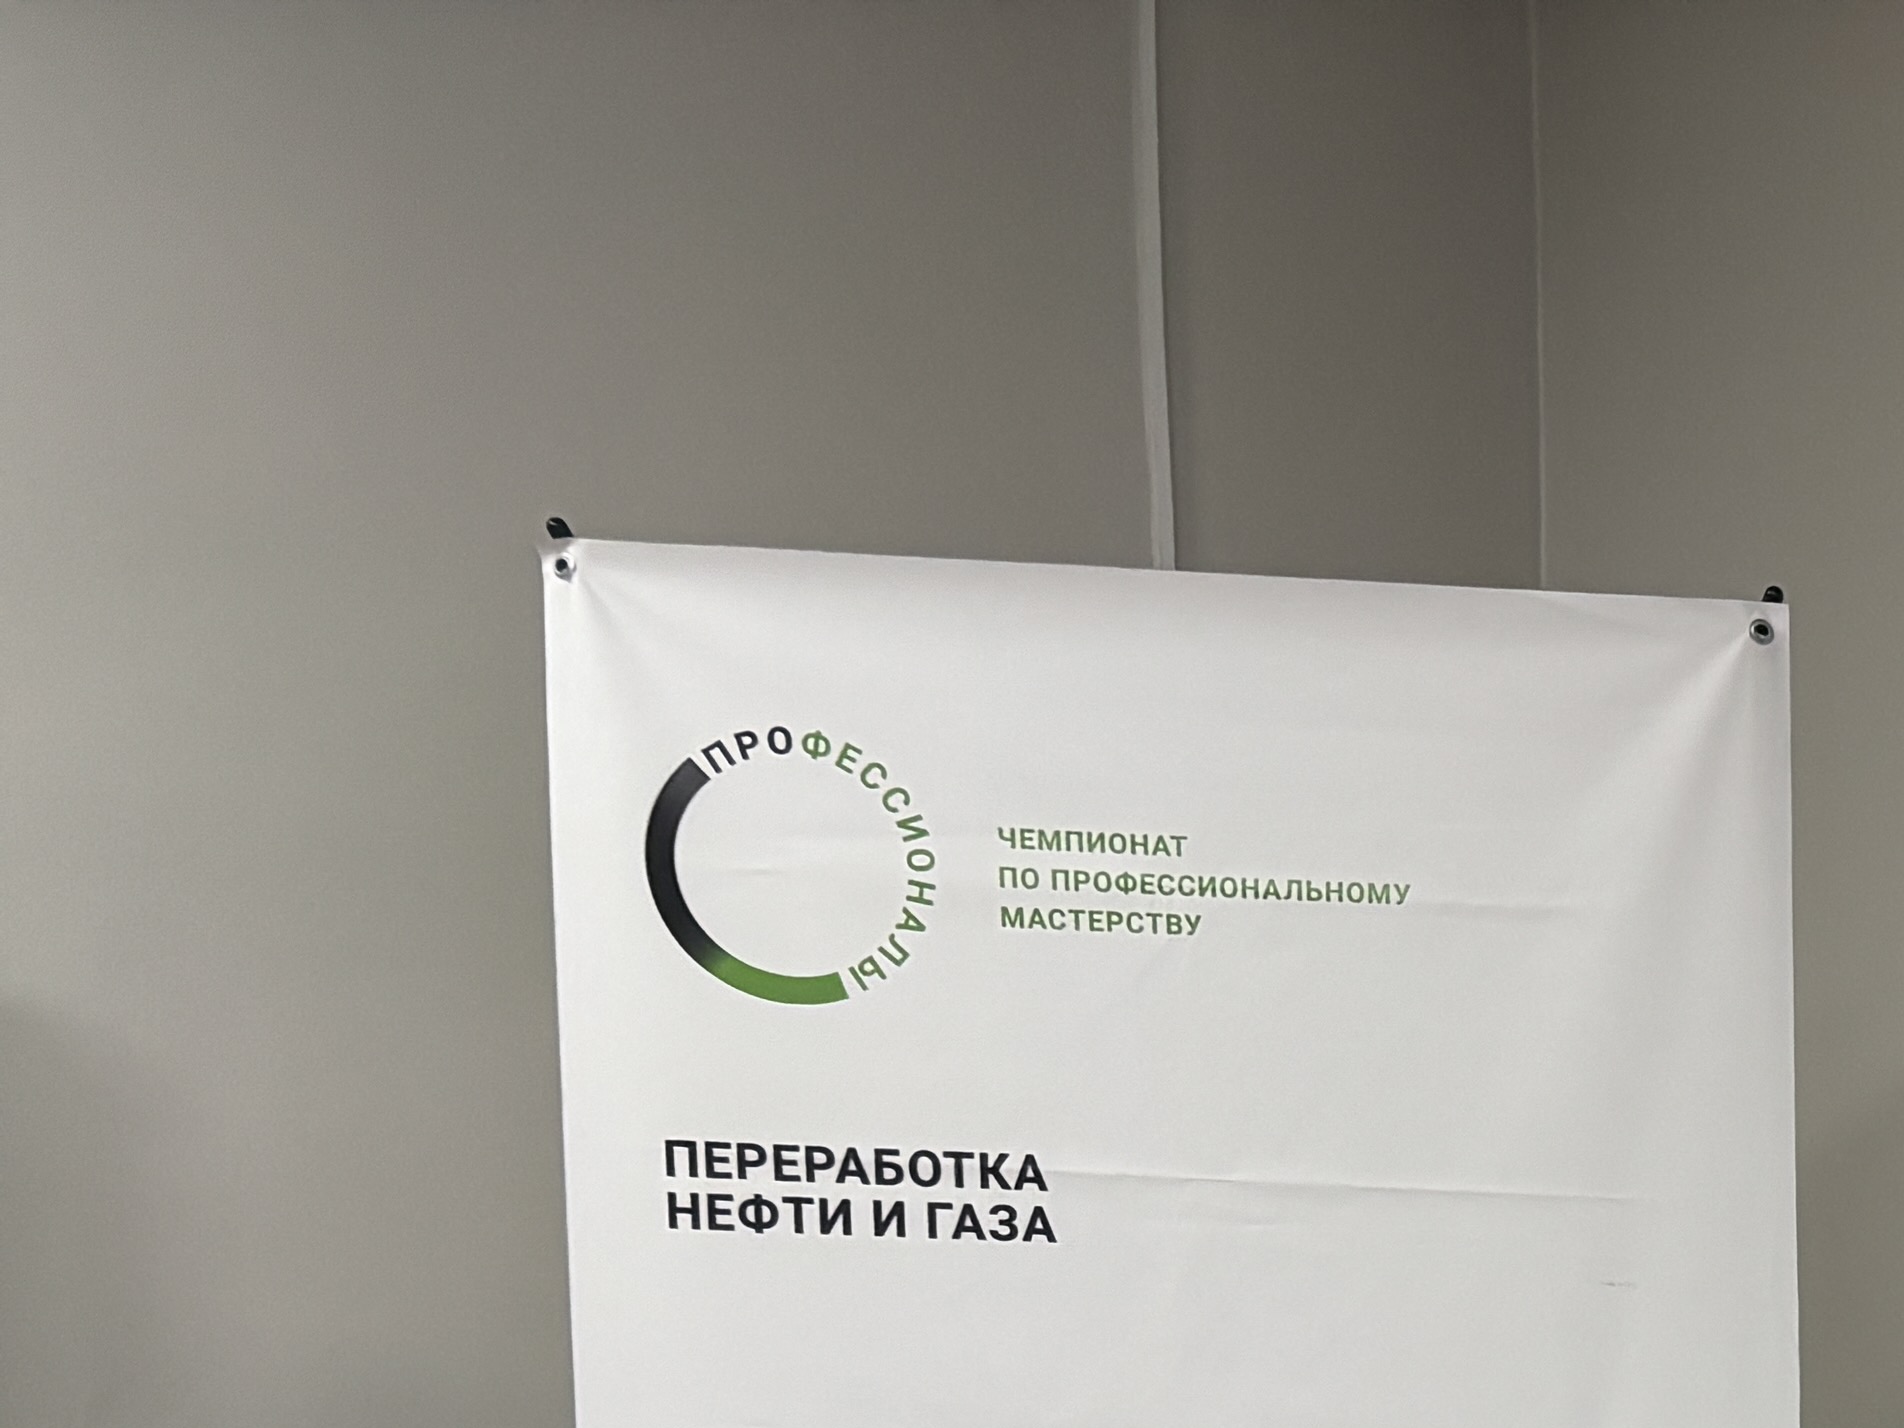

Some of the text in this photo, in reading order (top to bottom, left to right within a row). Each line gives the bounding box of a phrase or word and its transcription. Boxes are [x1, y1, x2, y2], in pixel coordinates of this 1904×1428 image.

[702, 725, 937, 992] ПРОФЕССИОНАЛЫ
[997, 827, 1188, 858] ЧЕМПИОНАТ
[999, 866, 1411, 906] ПО ПРОФЕССИОНАЛЬНОМУ
[999, 907, 1202, 937] МАСТЕРСТВУ
[663, 1139, 1049, 1192] ПЕРЕРАБОТКА
[666, 1192, 1058, 1244] НЕФТИ И ГАЗА
